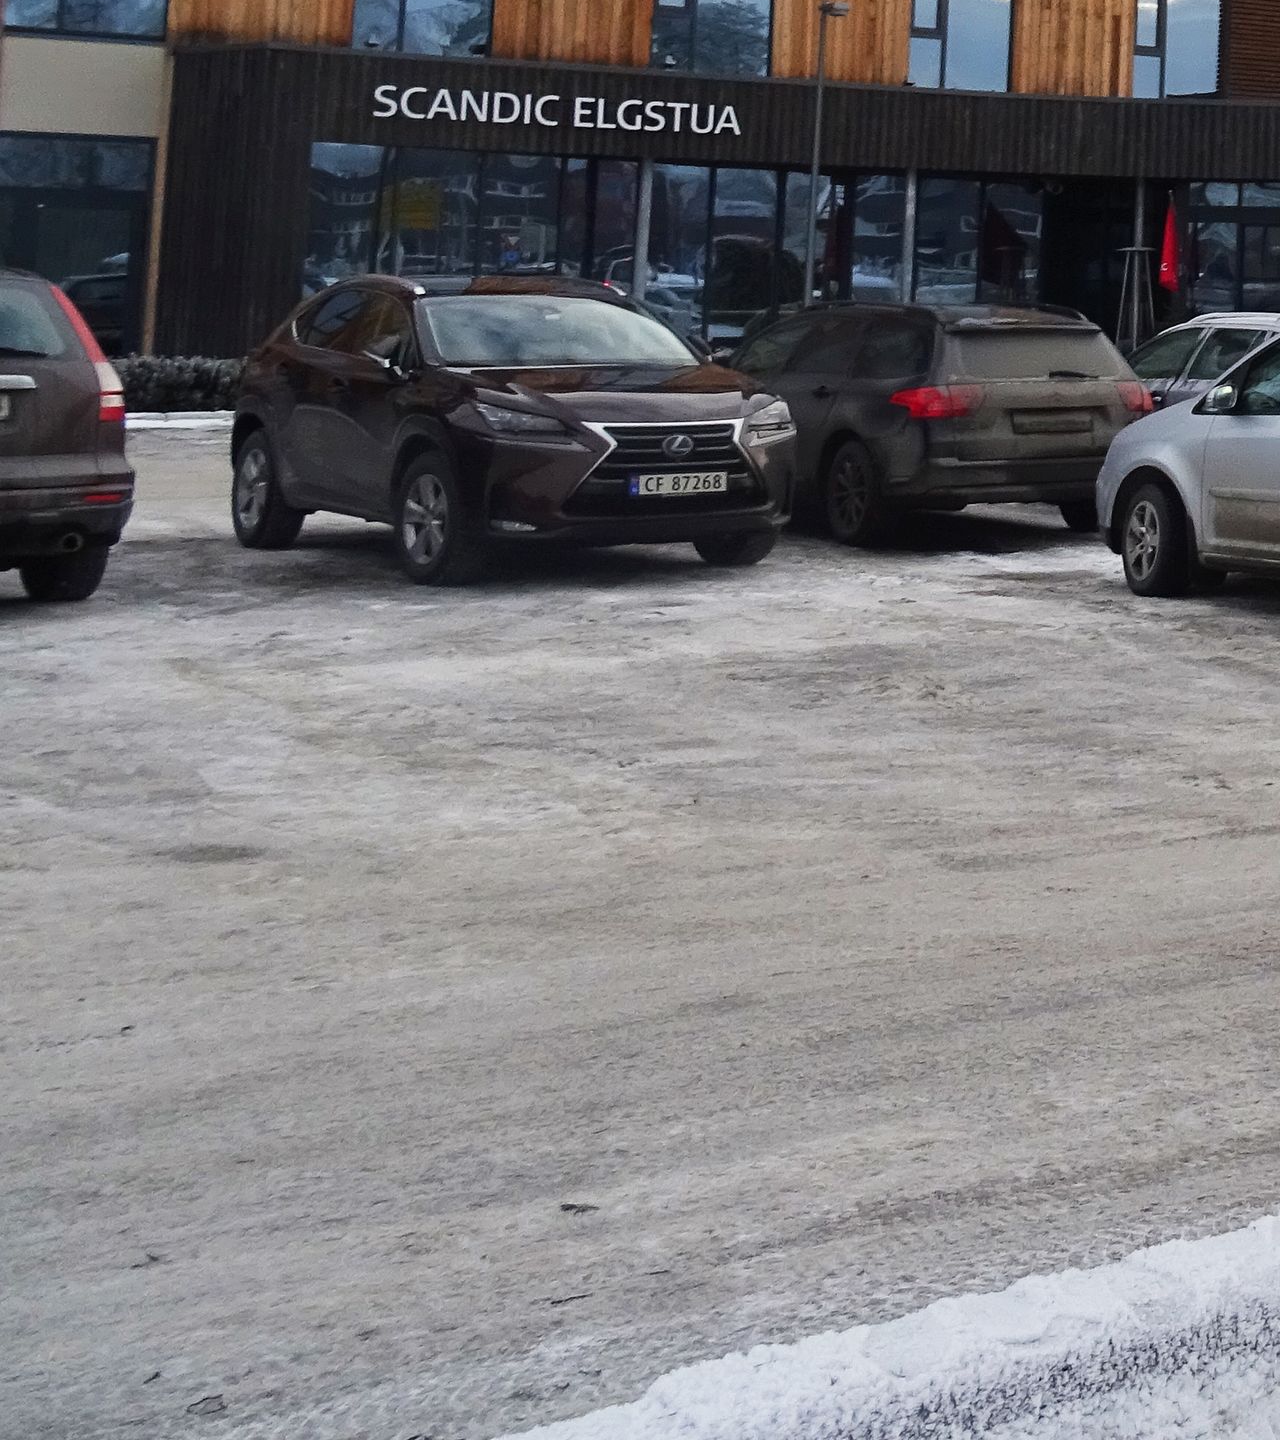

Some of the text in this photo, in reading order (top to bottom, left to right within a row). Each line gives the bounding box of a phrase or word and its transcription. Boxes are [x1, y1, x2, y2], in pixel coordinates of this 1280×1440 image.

[372, 84, 742, 136] SCANDIC ELGSTUA
[645, 474, 722, 492] CF 87268
